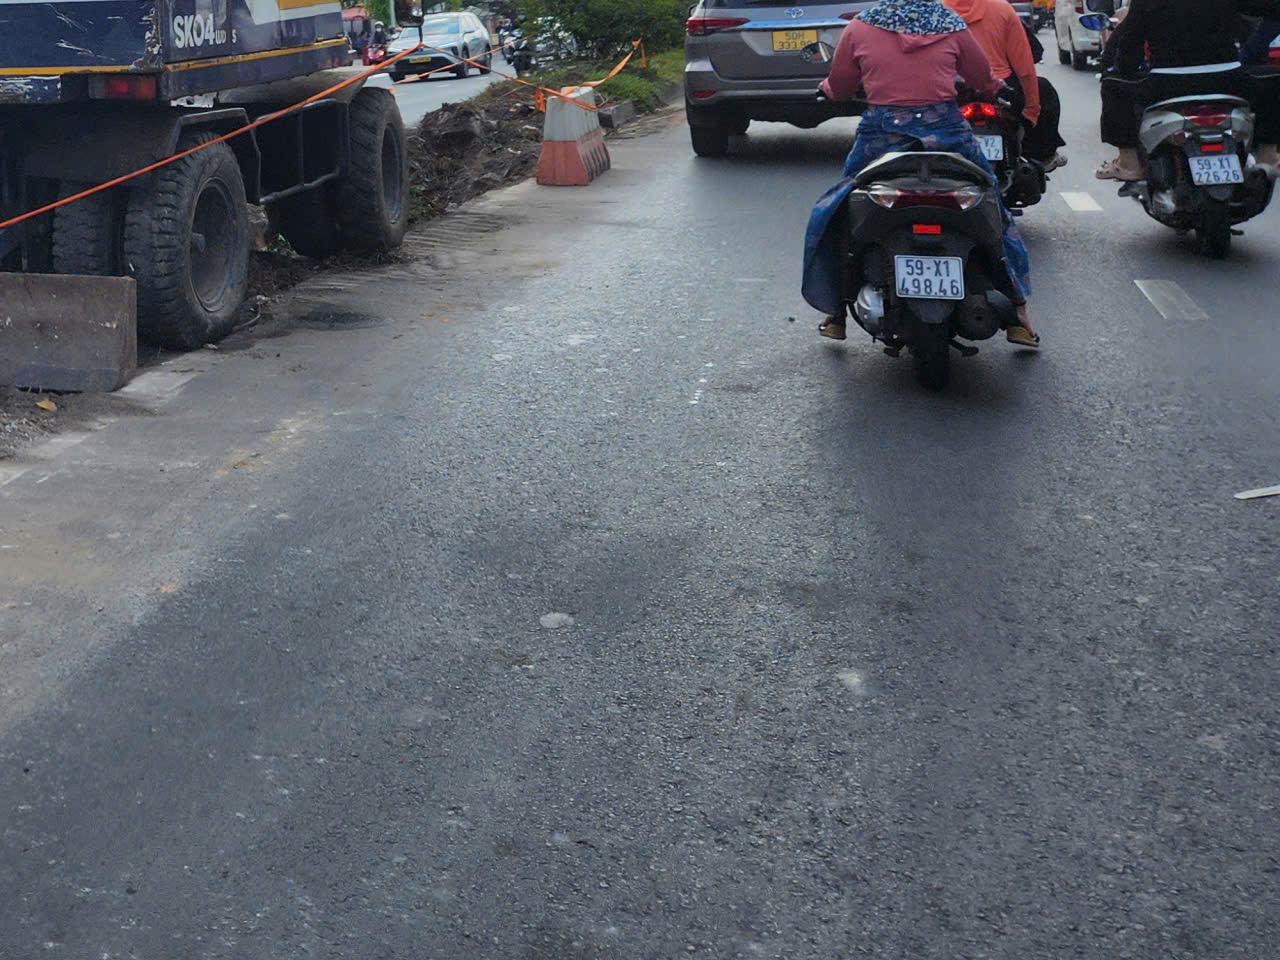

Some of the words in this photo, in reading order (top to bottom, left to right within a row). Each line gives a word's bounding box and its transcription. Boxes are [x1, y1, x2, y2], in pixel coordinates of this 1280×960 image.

[1197, 156, 1231, 170] 59-X1
[905, 259, 950, 277] 59-X1
[901, 277, 960, 296] 498.46
